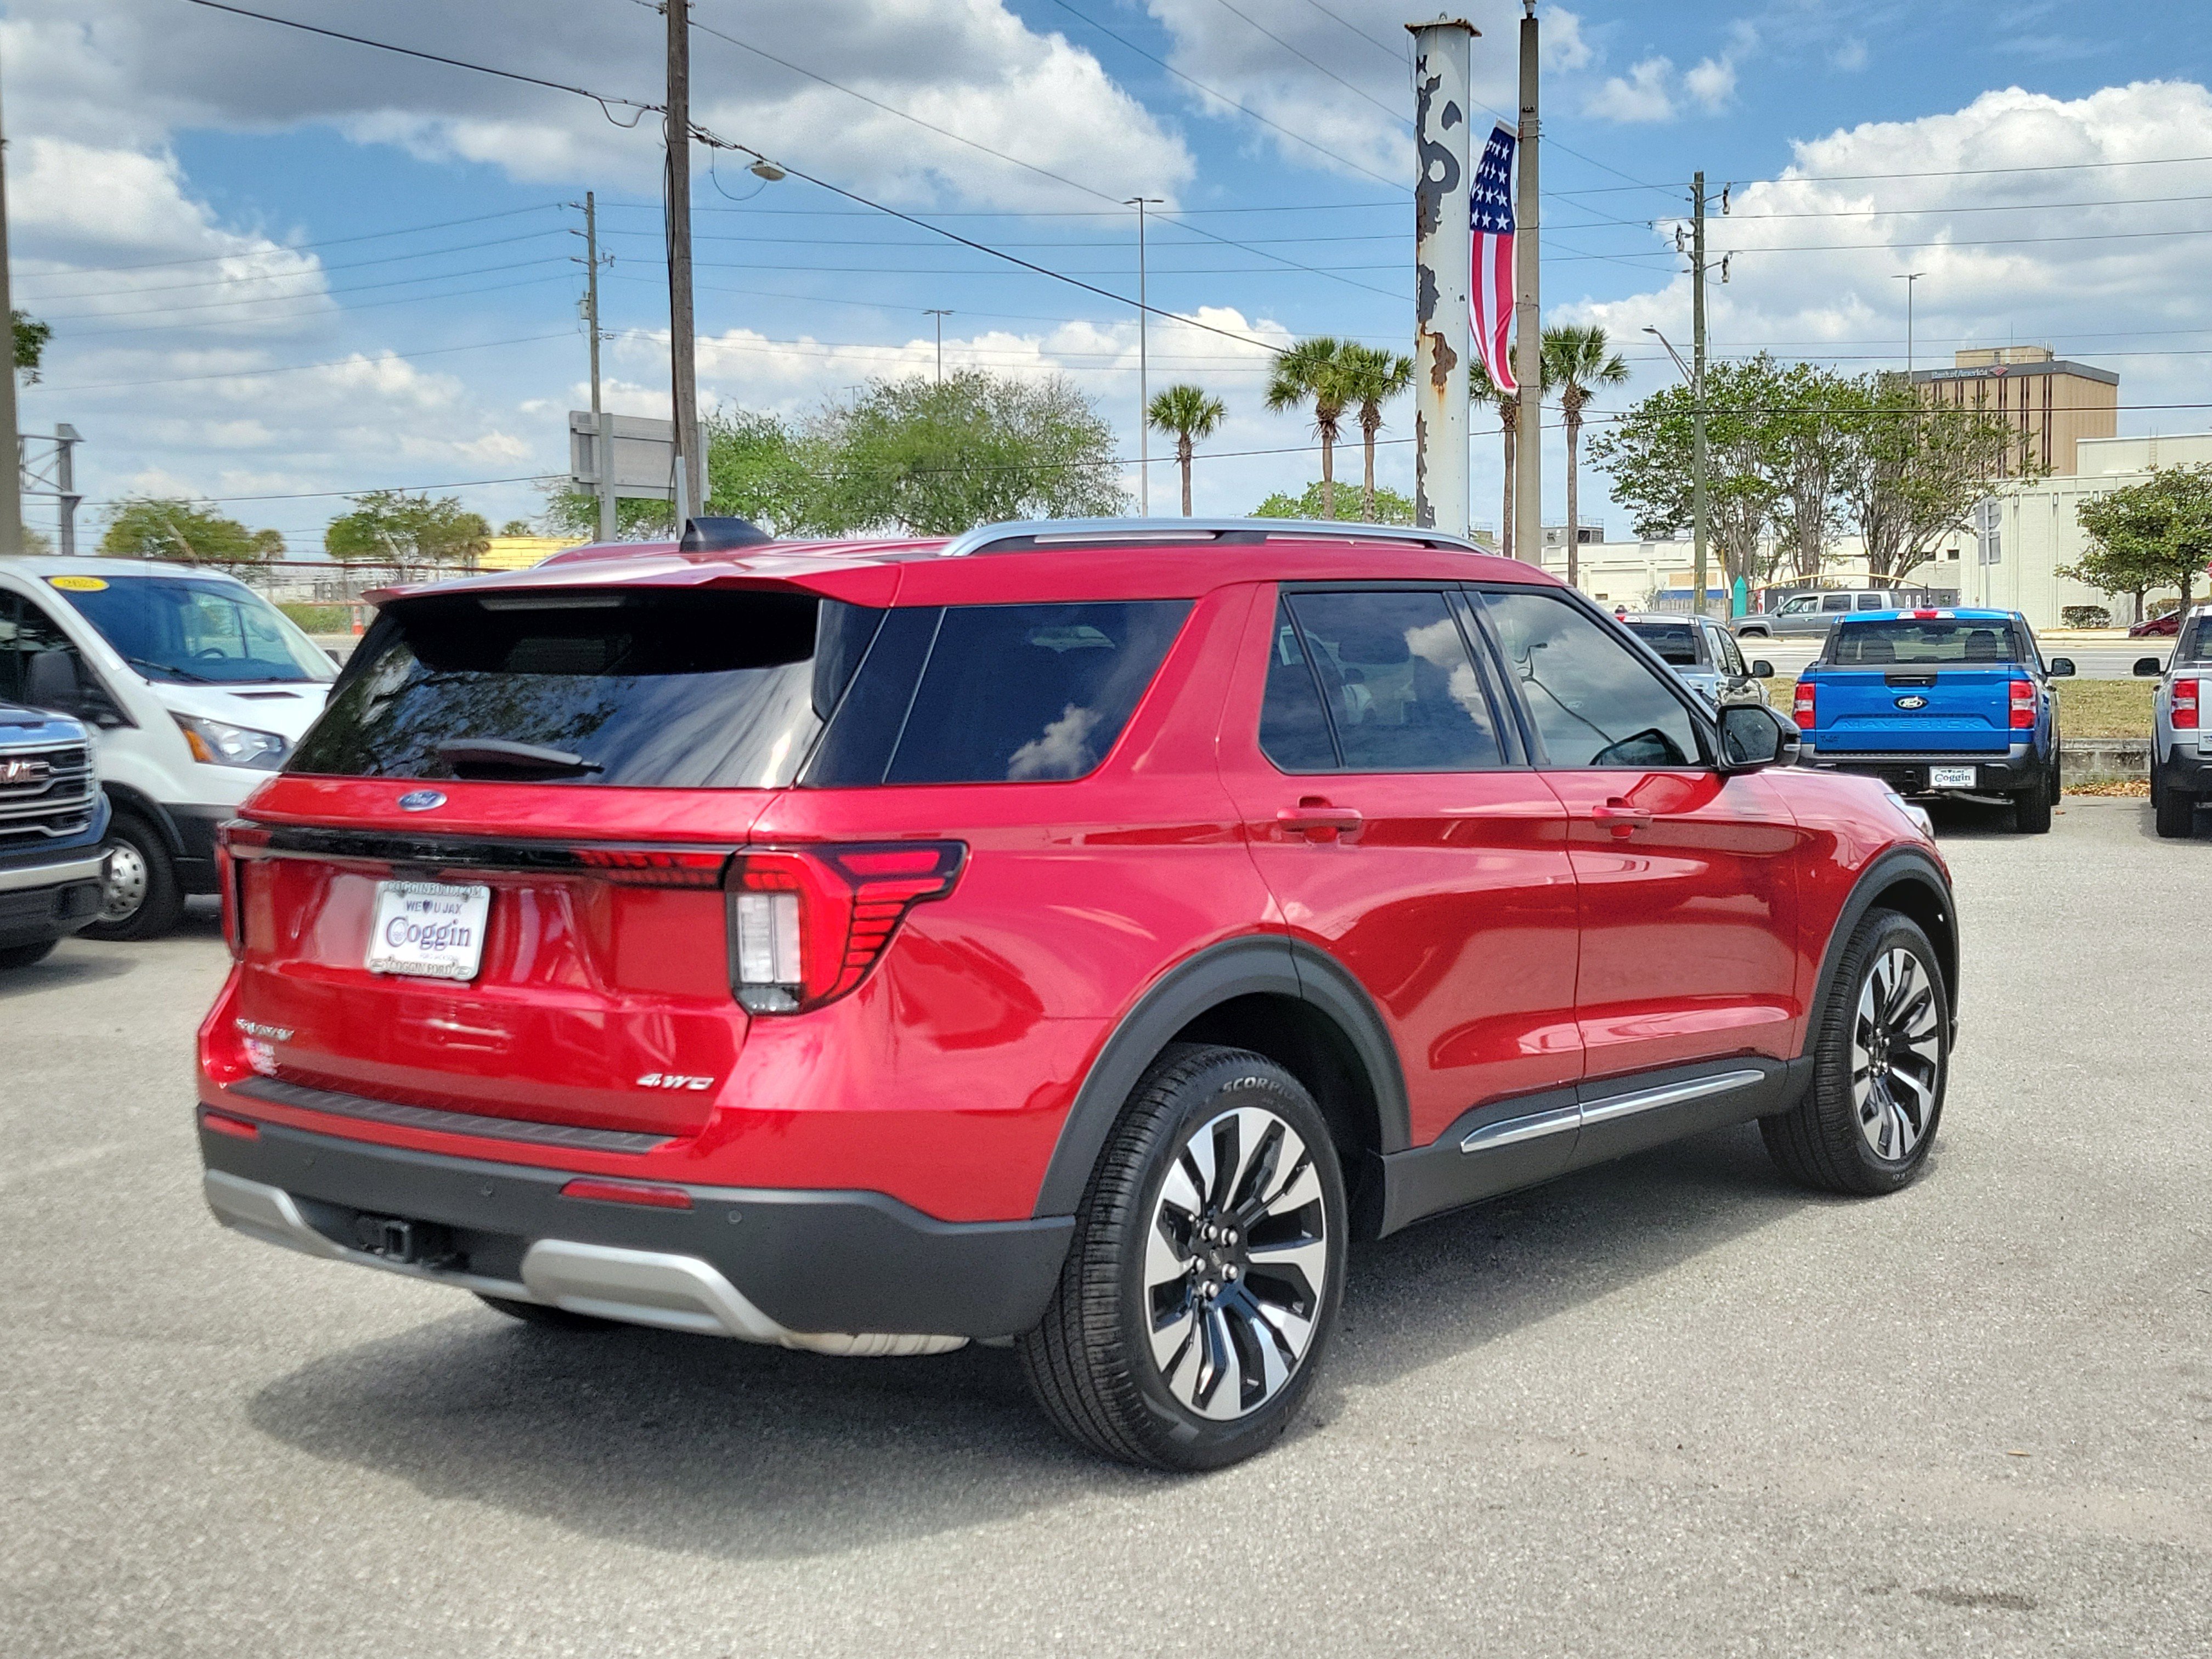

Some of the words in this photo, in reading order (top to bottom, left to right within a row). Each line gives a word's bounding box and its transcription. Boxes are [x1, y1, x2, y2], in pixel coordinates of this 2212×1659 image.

[1842, 720, 1980, 729] MAVERICK
[1934, 773, 1971, 782] Coggin
[406, 900, 421, 912] WE
[434, 902, 441, 913] U
[442, 904, 462, 914] JAX
[386, 916, 472, 951] Coggin
[636, 1073, 715, 1091] 4WD
